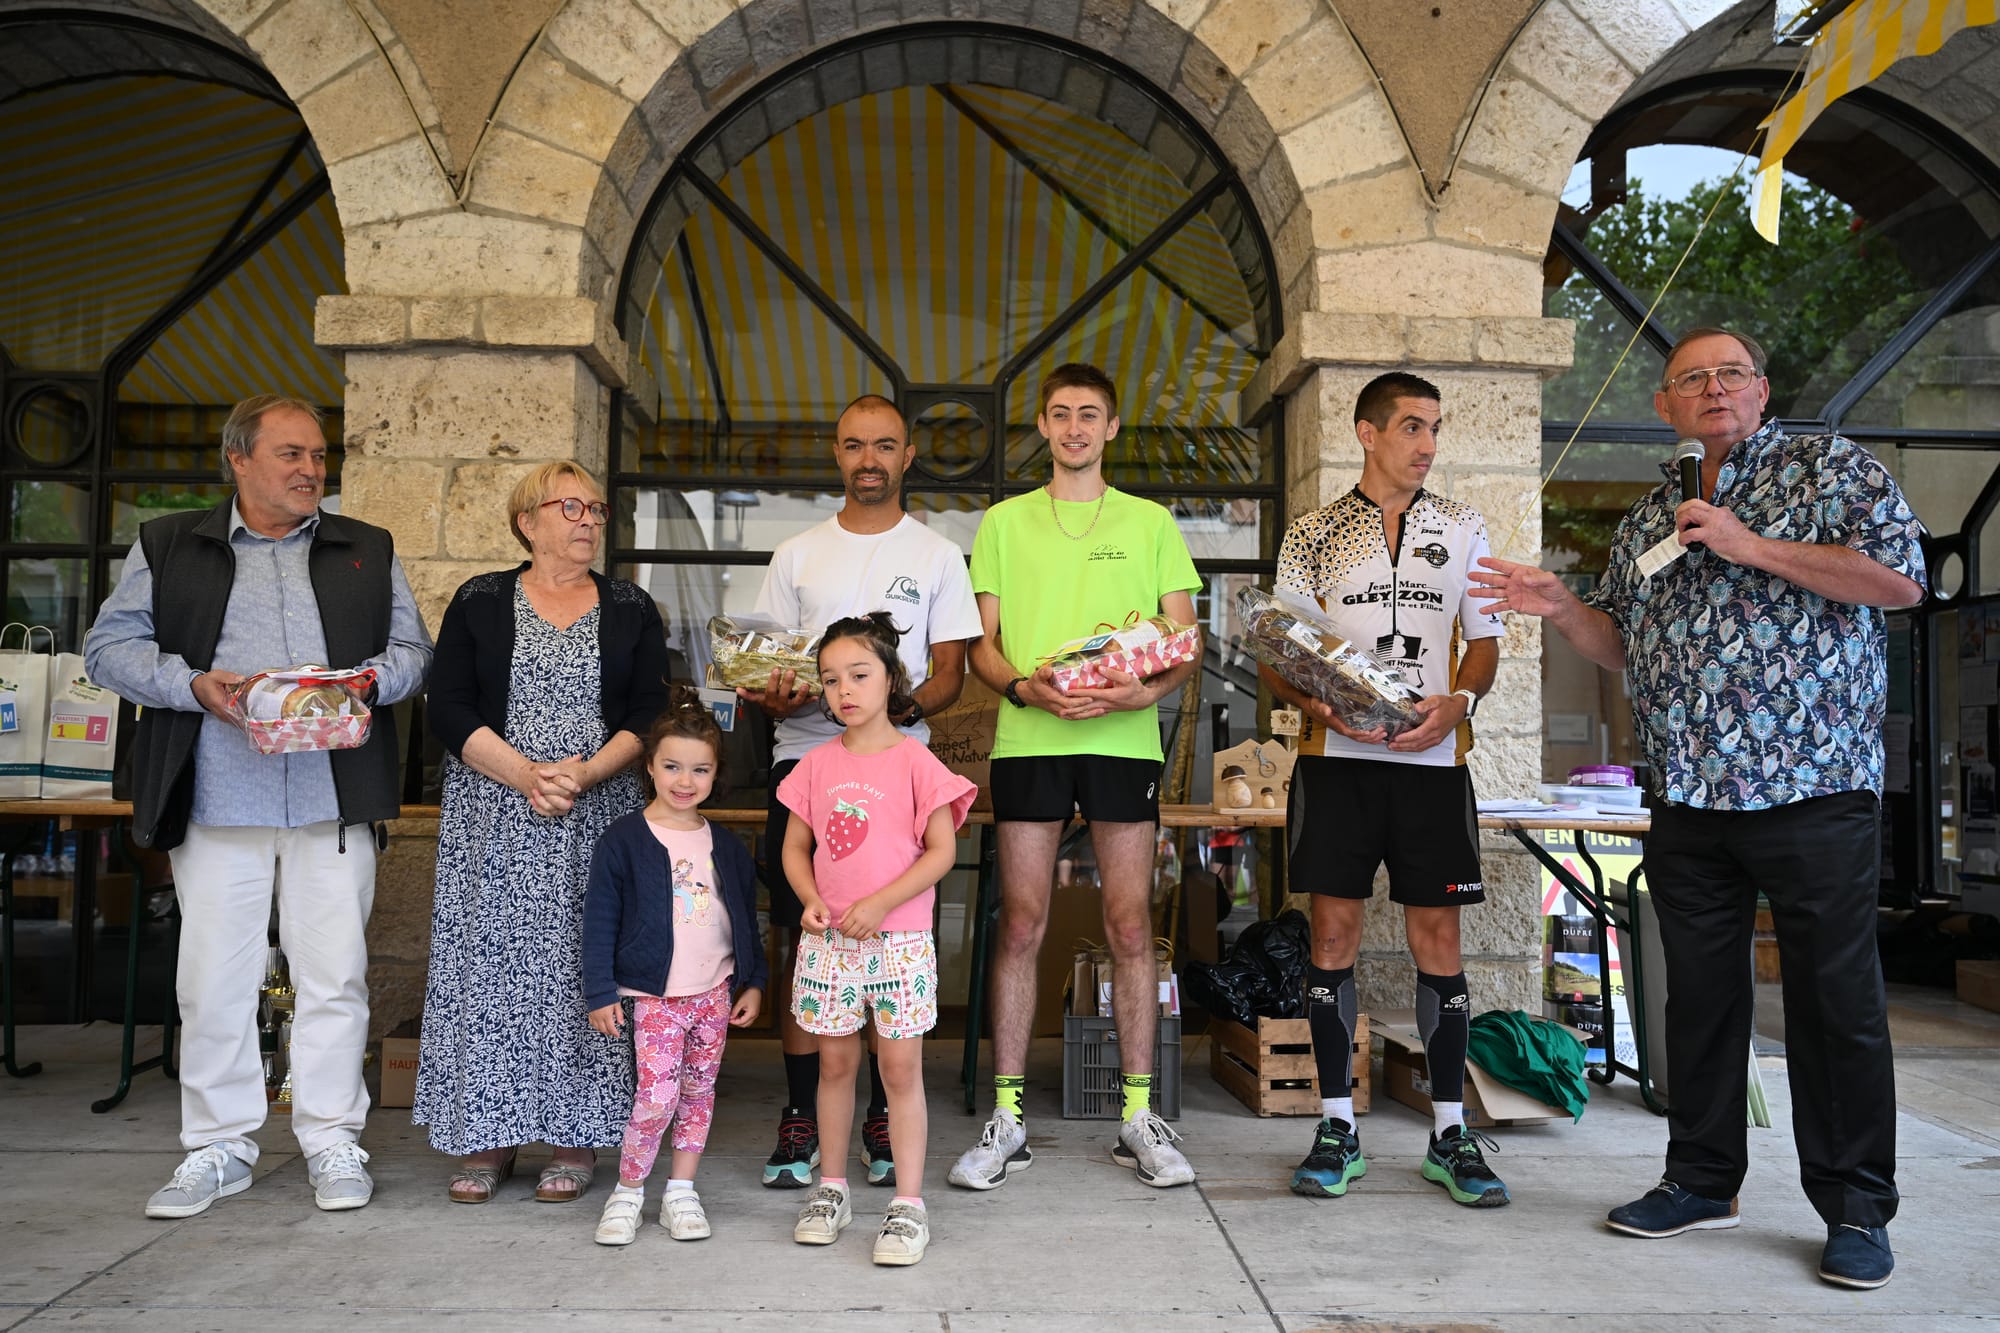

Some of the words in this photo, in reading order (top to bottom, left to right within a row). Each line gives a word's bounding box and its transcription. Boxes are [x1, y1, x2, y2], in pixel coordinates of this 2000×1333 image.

[1366, 581, 1393, 594] Jean
[1399, 580, 1427, 590] Marc
[1420, 602, 1444, 612] Filles
[3, 711, 13, 724] M
[715, 710, 729, 723] M
[57, 724, 65, 738] 1
[93, 723, 101, 735] F
[929, 736, 970, 757] espect
[951, 749, 991, 763] Natur
[826, 781, 860, 797] SUMMER
[863, 783, 885, 800] DAYS
[1457, 883, 1482, 892] PATRIC
[1577, 1022, 1604, 1032] DUPR
